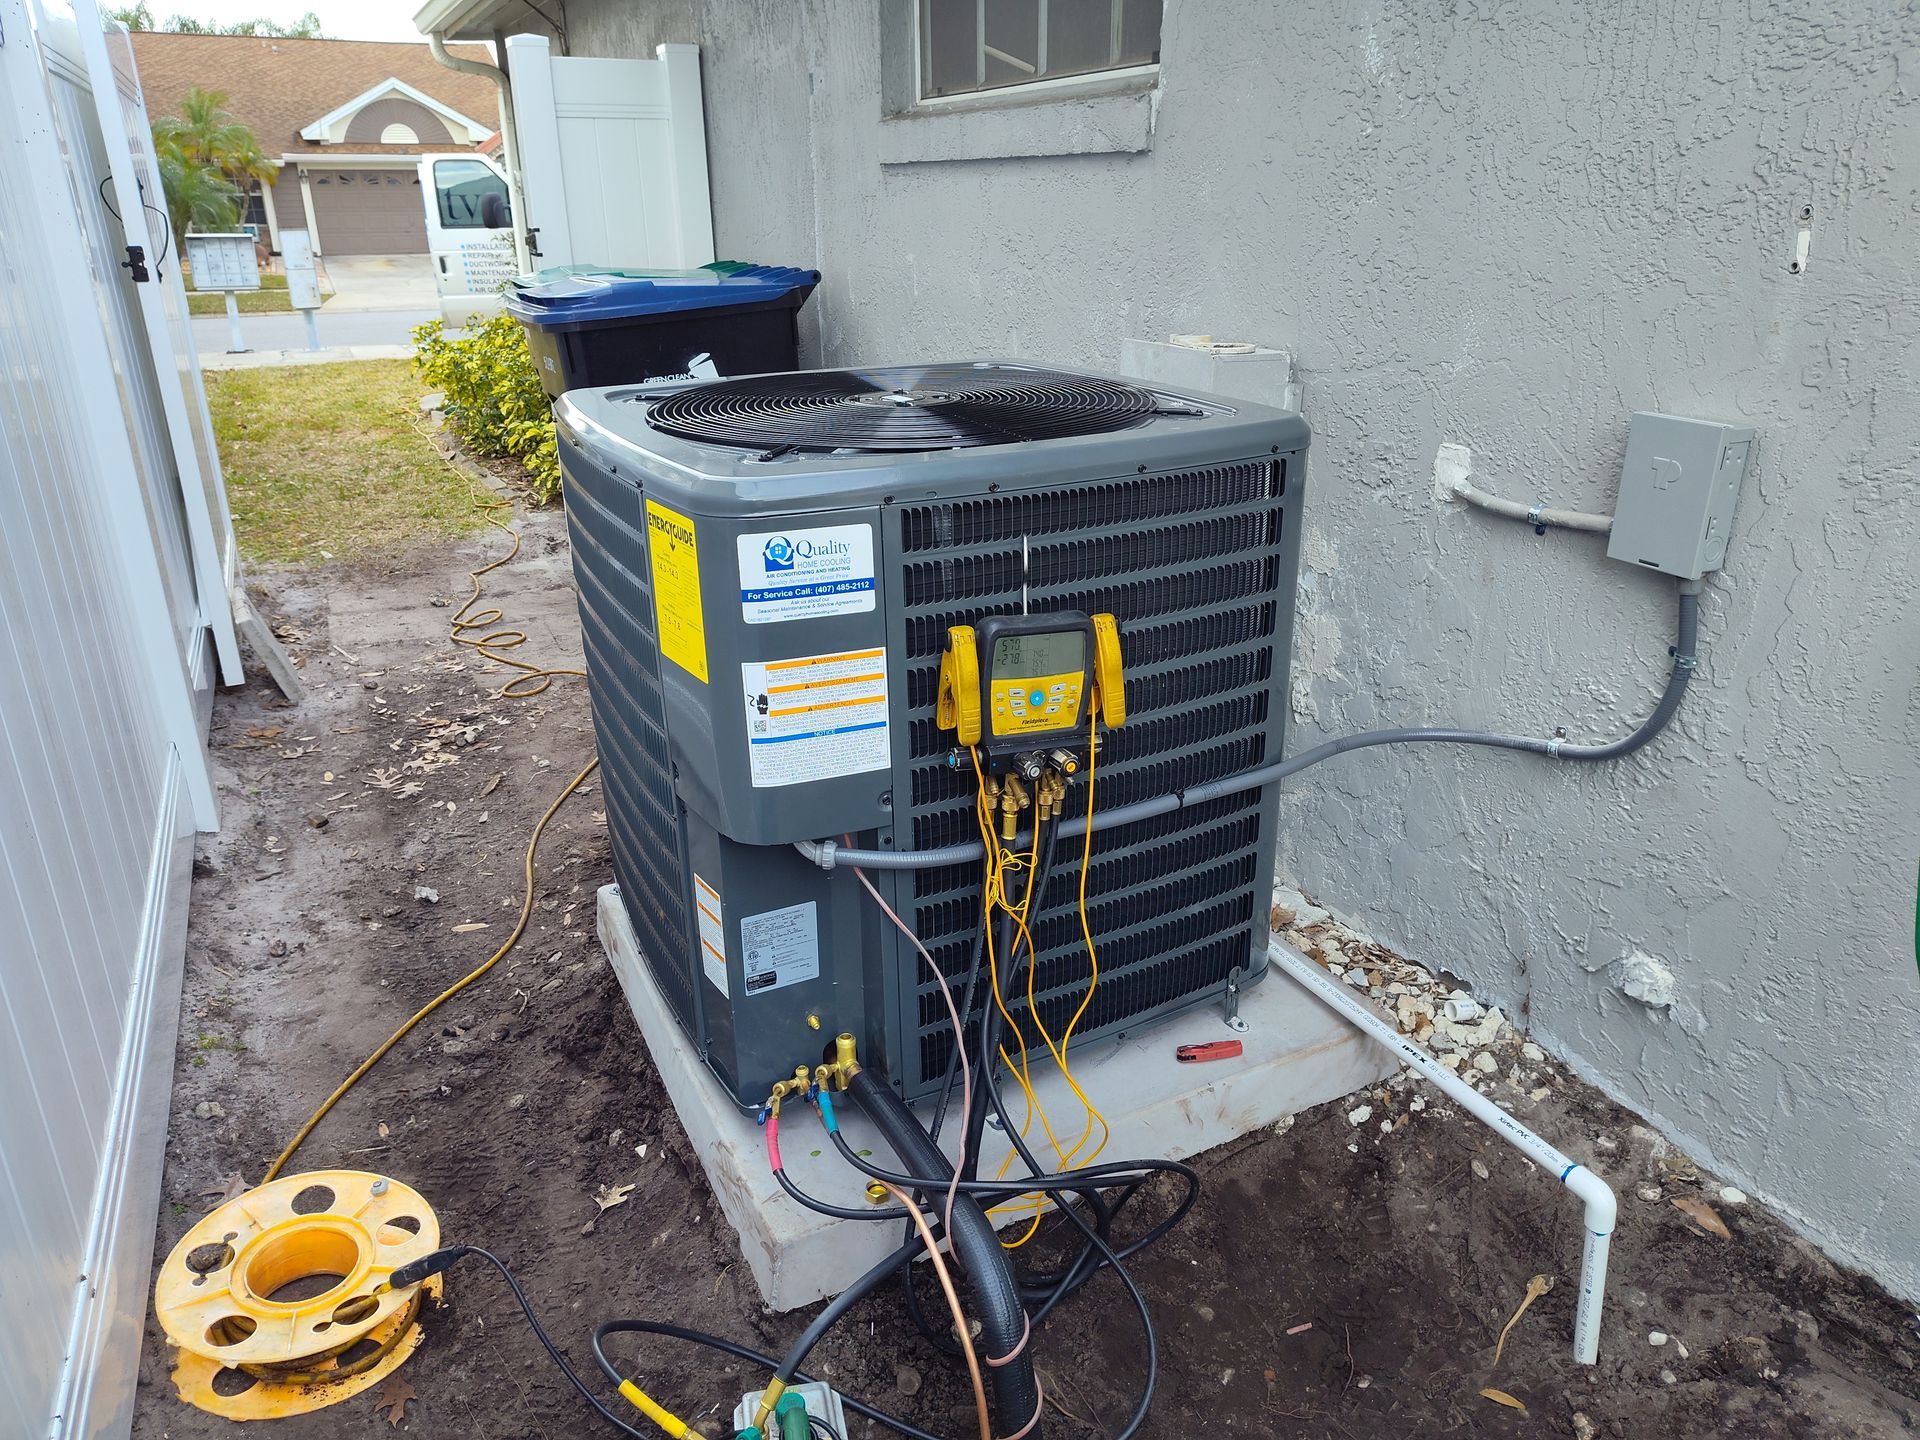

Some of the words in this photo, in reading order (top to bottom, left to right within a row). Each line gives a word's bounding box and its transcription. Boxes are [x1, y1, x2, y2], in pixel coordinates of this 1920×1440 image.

[796, 539, 850, 558] Quality
[798, 561, 818, 570] HOME
[820, 557, 851, 567] COOLING
[776, 569, 815, 578] CONDITIONING
[763, 590, 793, 599] Service
[795, 587, 813, 596] Call:
[815, 585, 835, 595] (407)
[836, 581, 869, 591] 485-2112
[817, 656, 846, 664] WARNING
[1402, 1045, 1428, 1064] IPEX
[1516, 1129, 1530, 1140] PVC
